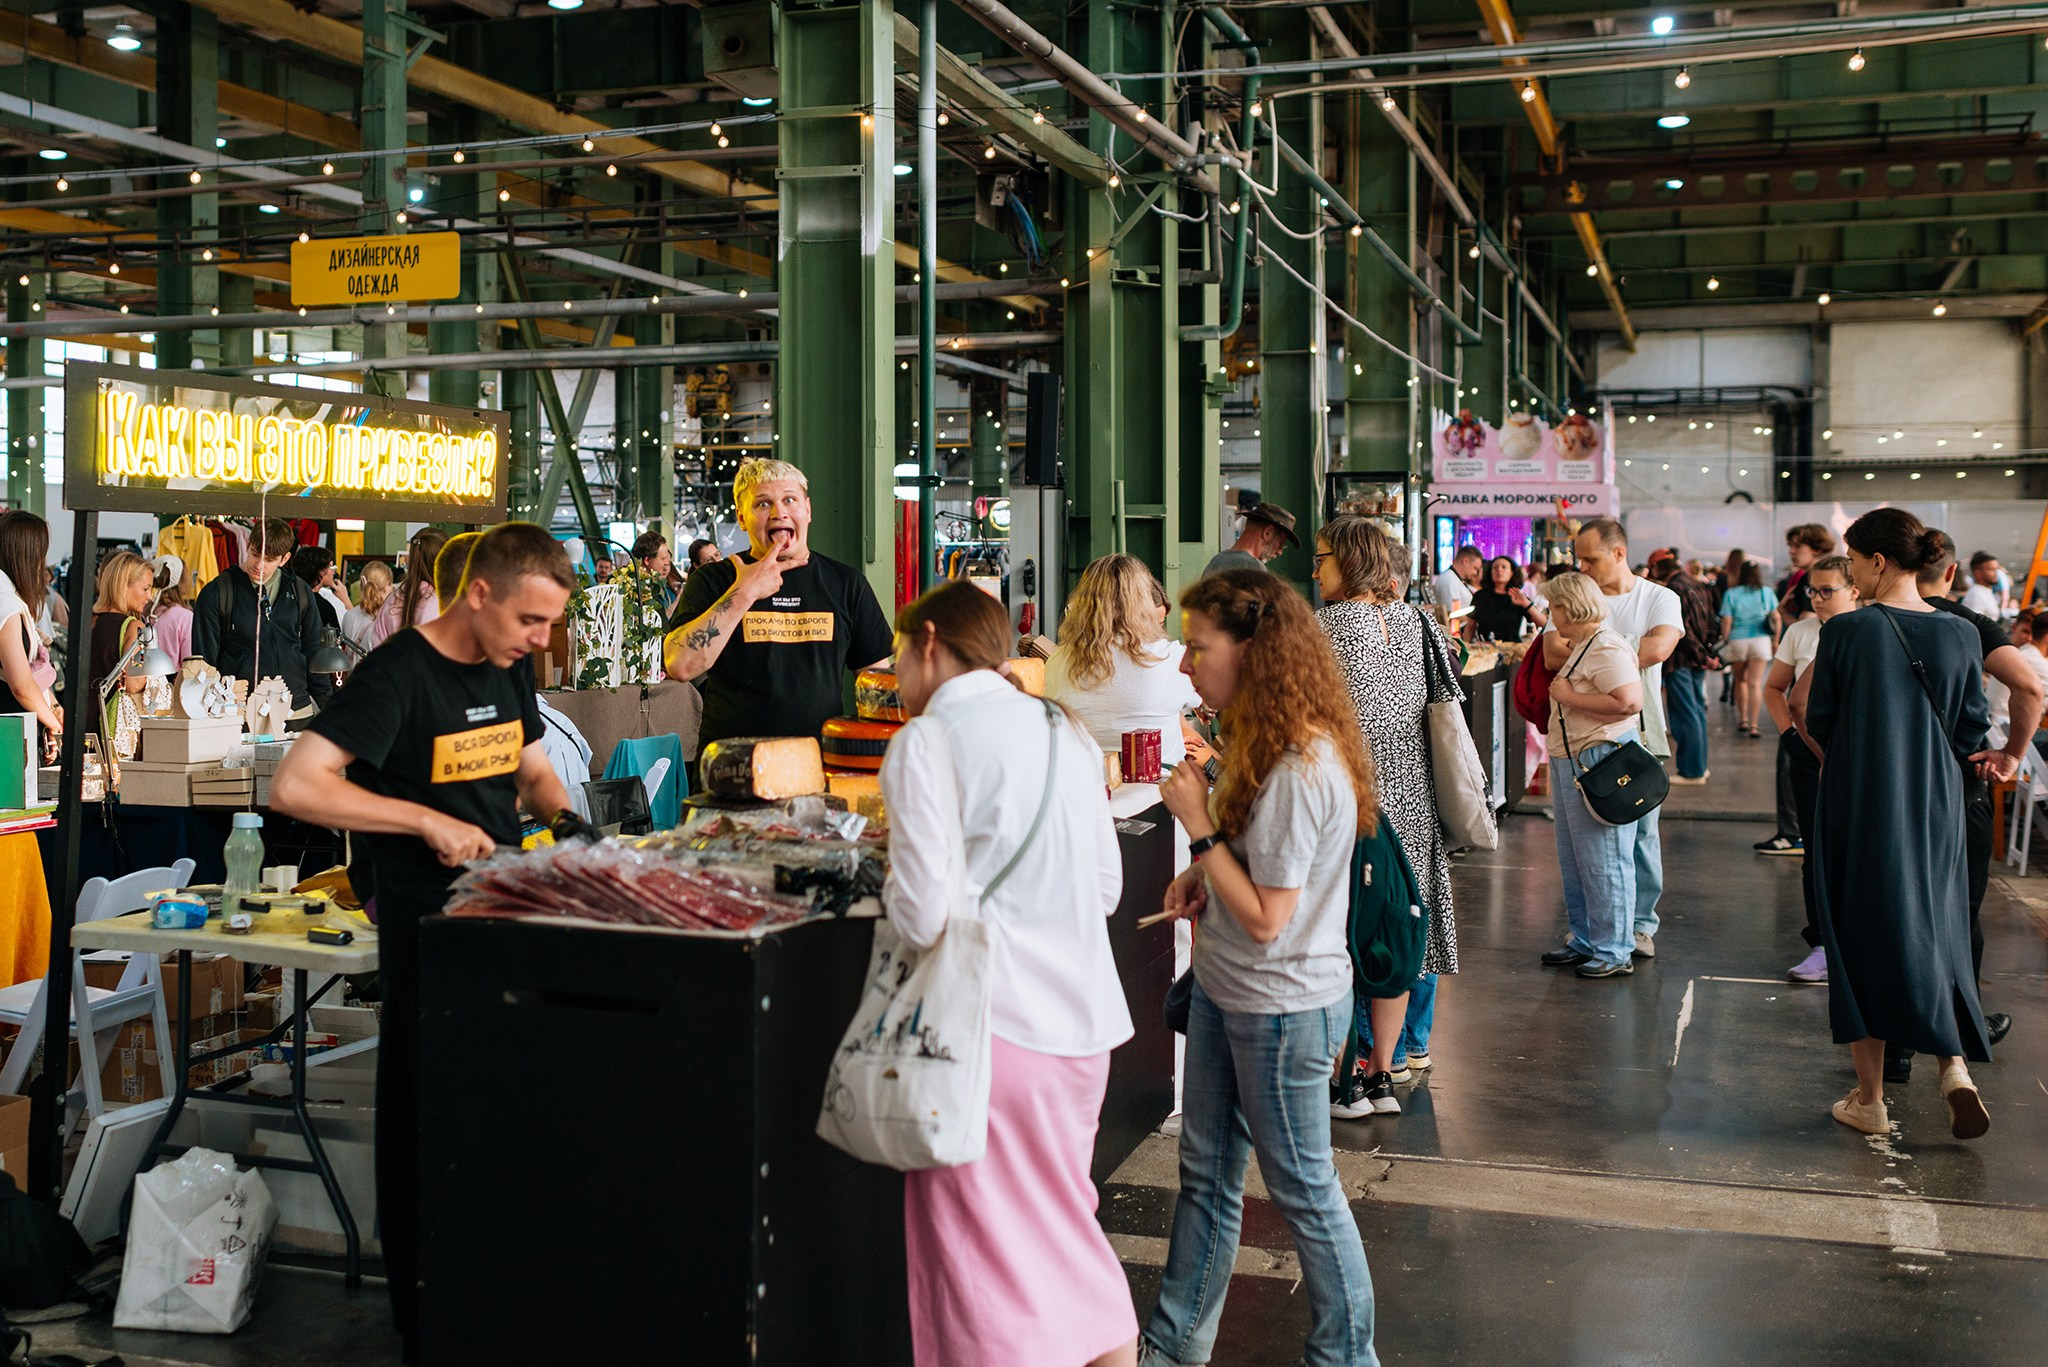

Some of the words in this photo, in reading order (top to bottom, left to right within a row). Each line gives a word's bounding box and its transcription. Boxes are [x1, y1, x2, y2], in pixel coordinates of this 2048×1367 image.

[329, 243, 420, 272] ДИЗАЙНЕРСКАЯ
[347, 273, 399, 297] ОДЕЖДА
[104, 390, 190, 479] КАК
[193, 408, 253, 485] ВЫ
[257, 415, 328, 488] ЭТО
[330, 423, 498, 498] ПРИВЕЗЛИ?
[1441, 494, 1489, 504] ЛАВКА
[745, 617, 783, 625] ПРОКАЧУ
[798, 617, 828, 626] ЕВРОПЕ
[768, 629, 803, 637] БИЛЕТОВ
[804, 628, 810, 636] И
[812, 628, 827, 636] ВИЗ
[443, 763, 453, 775] В
